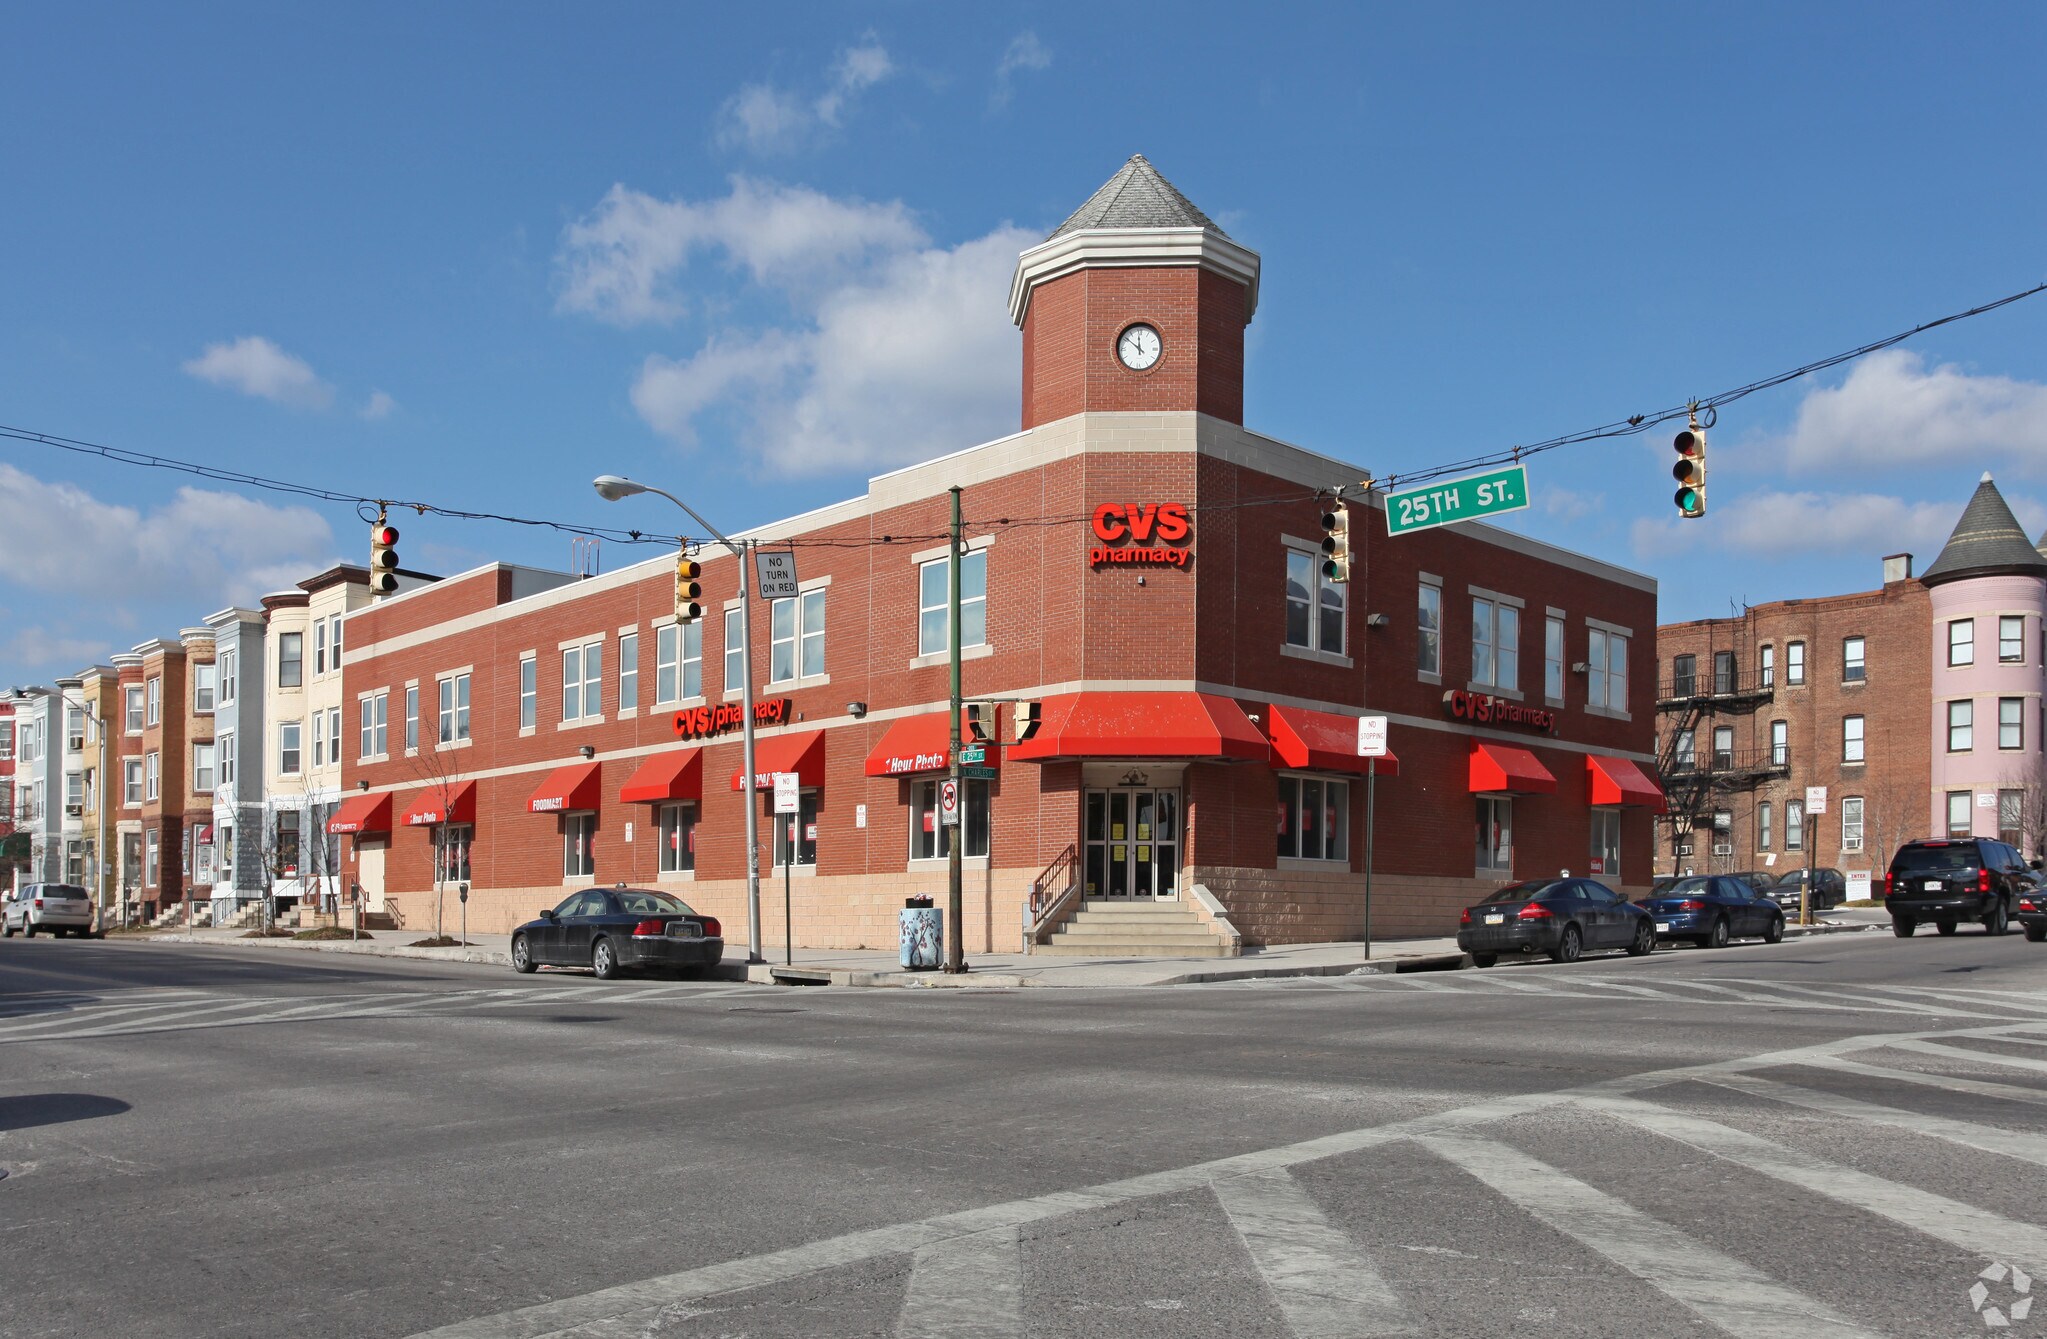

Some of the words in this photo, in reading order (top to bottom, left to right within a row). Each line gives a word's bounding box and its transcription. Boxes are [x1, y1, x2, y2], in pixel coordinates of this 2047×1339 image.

[1398, 488, 1460, 526] 25TH
[1477, 480, 1515, 507] ST.
[1091, 502, 1189, 541] CVS
[1089, 545, 1190, 567] pharmacy
[768, 557, 783, 567] NO
[766, 570, 789, 580] TURN
[762, 584, 775, 593] ON
[778, 583, 795, 592] RED
[1450, 689, 1555, 732] CVS/pharmacy
[1368, 720, 1377, 729] NO
[1360, 732, 1384, 740] STOPPING
[891, 757, 914, 773] Hour
[915, 753, 943, 770] Photo
[968, 769, 989, 778] CHARLES
[782, 777, 791, 786] NO
[776, 789, 798, 798] STOPPING
[532, 797, 563, 811] FOODMART
